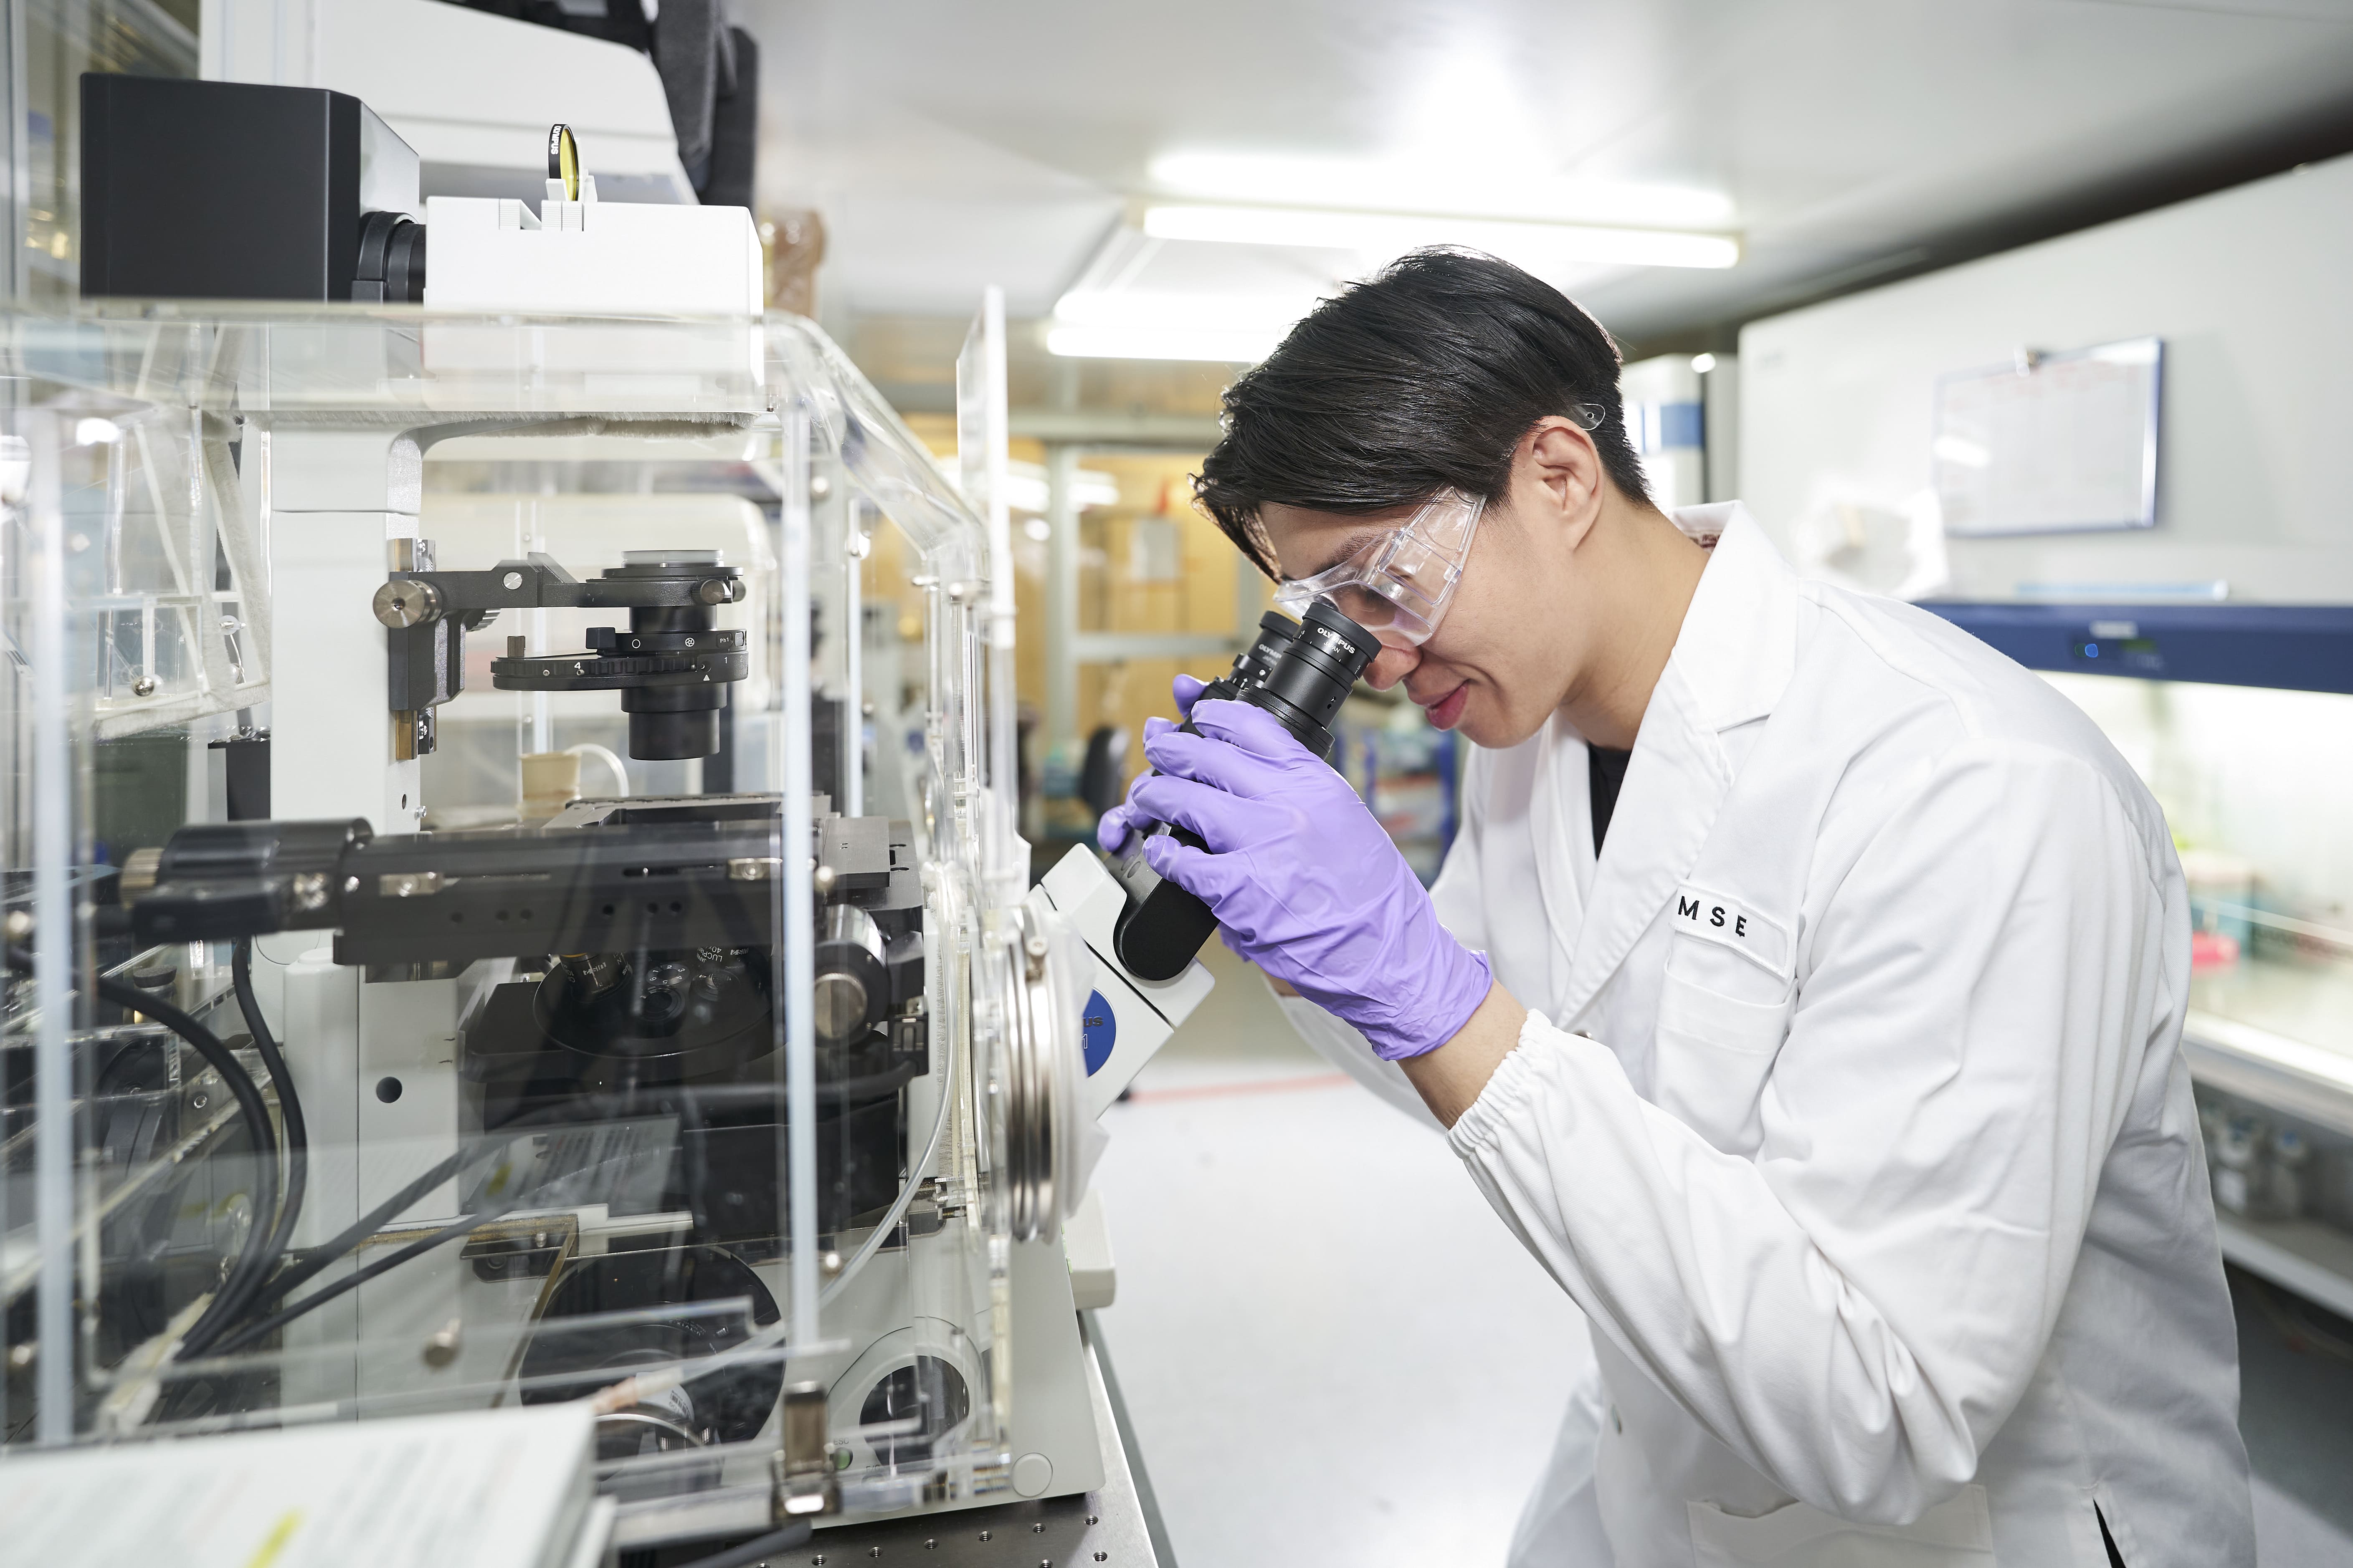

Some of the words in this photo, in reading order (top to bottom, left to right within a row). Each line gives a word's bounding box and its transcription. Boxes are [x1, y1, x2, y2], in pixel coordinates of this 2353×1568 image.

[551, 126, 562, 155] OLYMPUS
[1317, 627, 1355, 654] OLYMPUS
[1323, 641, 1340, 653] JAPAN
[1258, 644, 1282, 659] OLYMP
